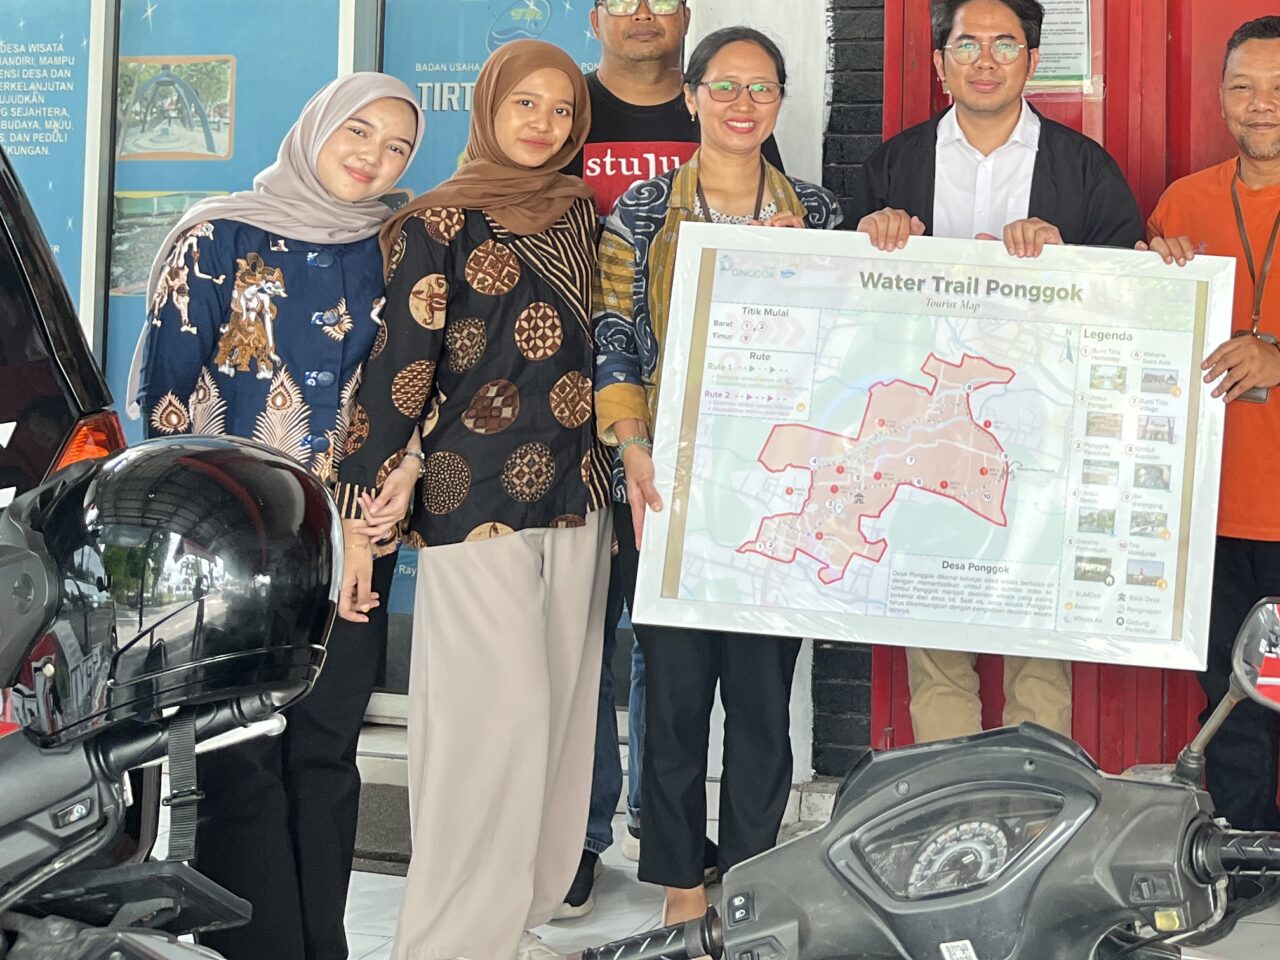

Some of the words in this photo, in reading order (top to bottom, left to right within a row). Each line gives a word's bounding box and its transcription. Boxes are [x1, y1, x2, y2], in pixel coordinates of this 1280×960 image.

[1, 44, 25, 53] DESA
[28, 43, 64, 53] WISATA
[39, 56, 75, 65] MAMPU
[415, 62, 448, 72] BADAN
[449, 62, 481, 72] USAHA
[22, 69, 48, 79] DESA
[50, 69, 71, 78] DAN
[9, 133, 30, 142] DAN
[32, 132, 67, 142] PEDULI
[859, 270, 926, 291] Water
[932, 275, 979, 295] Trail
[985, 279, 1084, 303] Ponggok
[925, 298, 957, 310] Tourist
[960, 300, 981, 313] Map
[742, 306, 761, 316] Titik
[764, 308, 789, 318] Mulai
[713, 320, 733, 328] Barat
[712, 333, 733, 341] Timur
[1083, 328, 1133, 342] Legenda
[749, 352, 771, 361] Rute
[708, 362, 726, 371] Rute
[704, 390, 723, 399] Rute
[942, 560, 966, 571] Desa
[968, 563, 1010, 574] Ponggok
